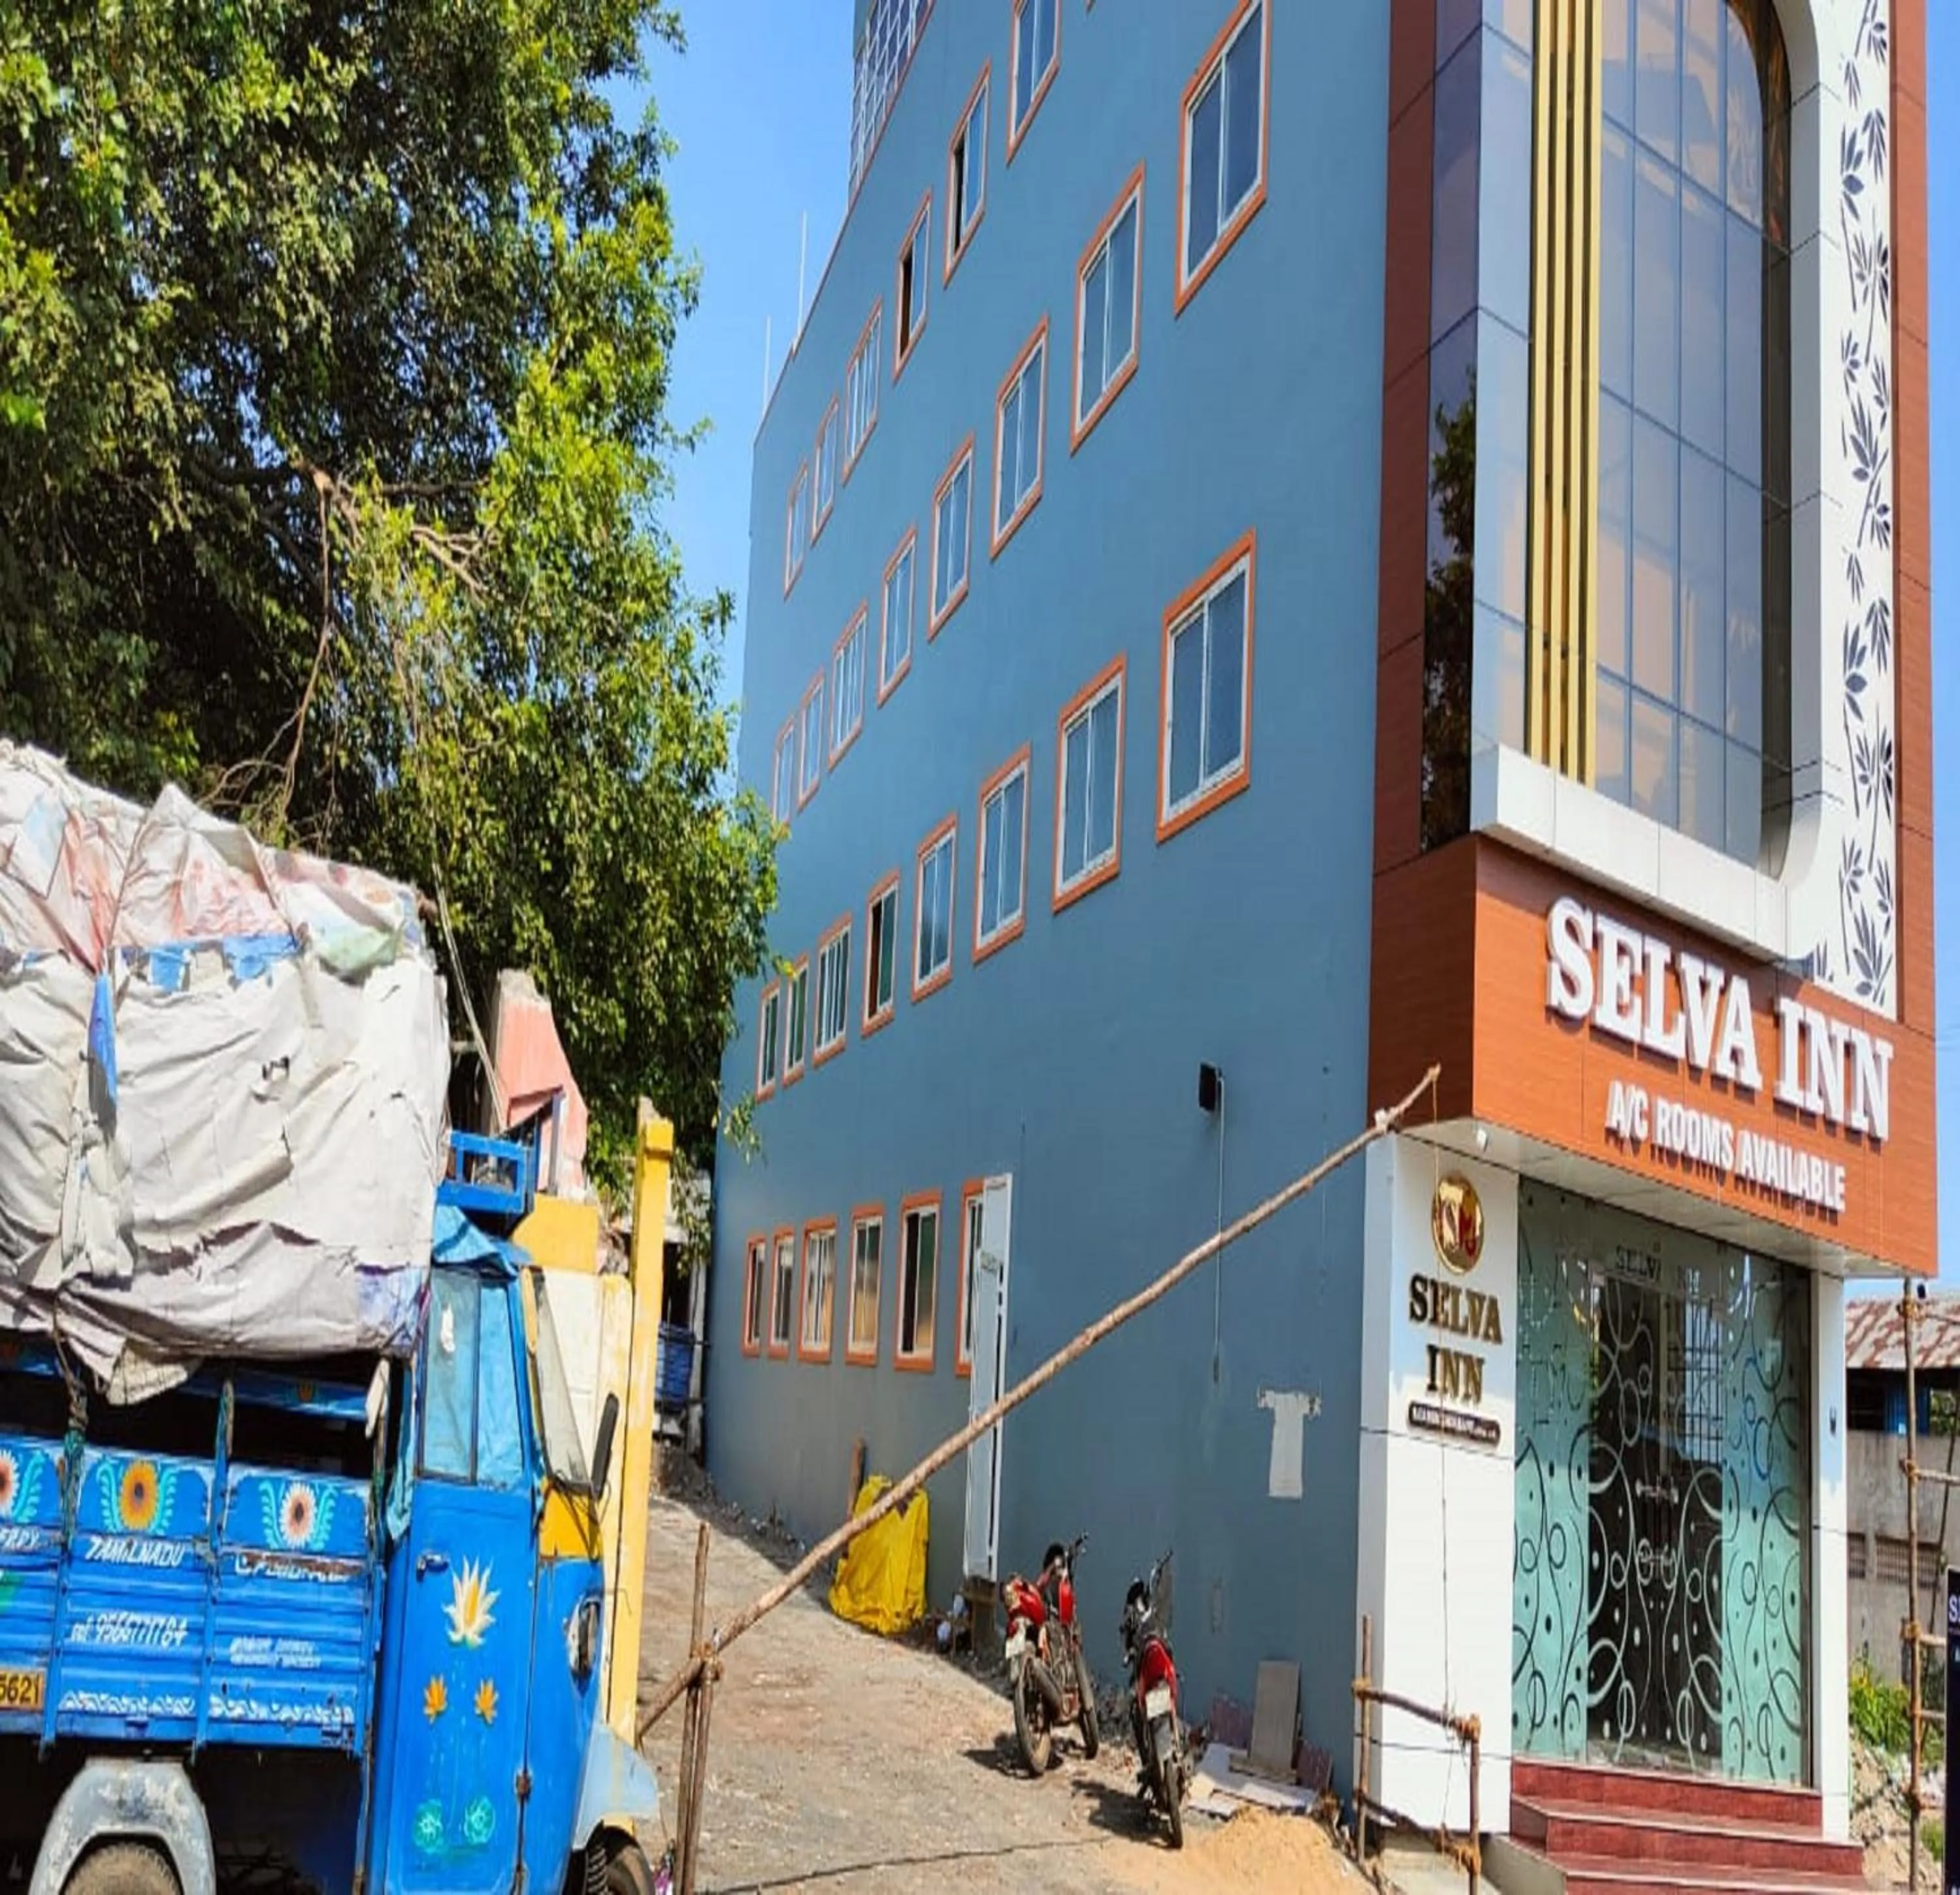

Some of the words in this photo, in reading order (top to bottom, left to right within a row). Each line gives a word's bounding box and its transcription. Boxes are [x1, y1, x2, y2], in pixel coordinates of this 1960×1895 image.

[1546, 897, 1763, 1092] SELVA
[1774, 996, 1894, 1144] INN
[1605, 1079, 1650, 1142] A/C
[1653, 1096, 1735, 1171] ROOMS
[1735, 1129, 1846, 1214] AVAILABLE
[1409, 1272, 1503, 1345] SELVA
[1426, 1343, 1485, 1405] INN
